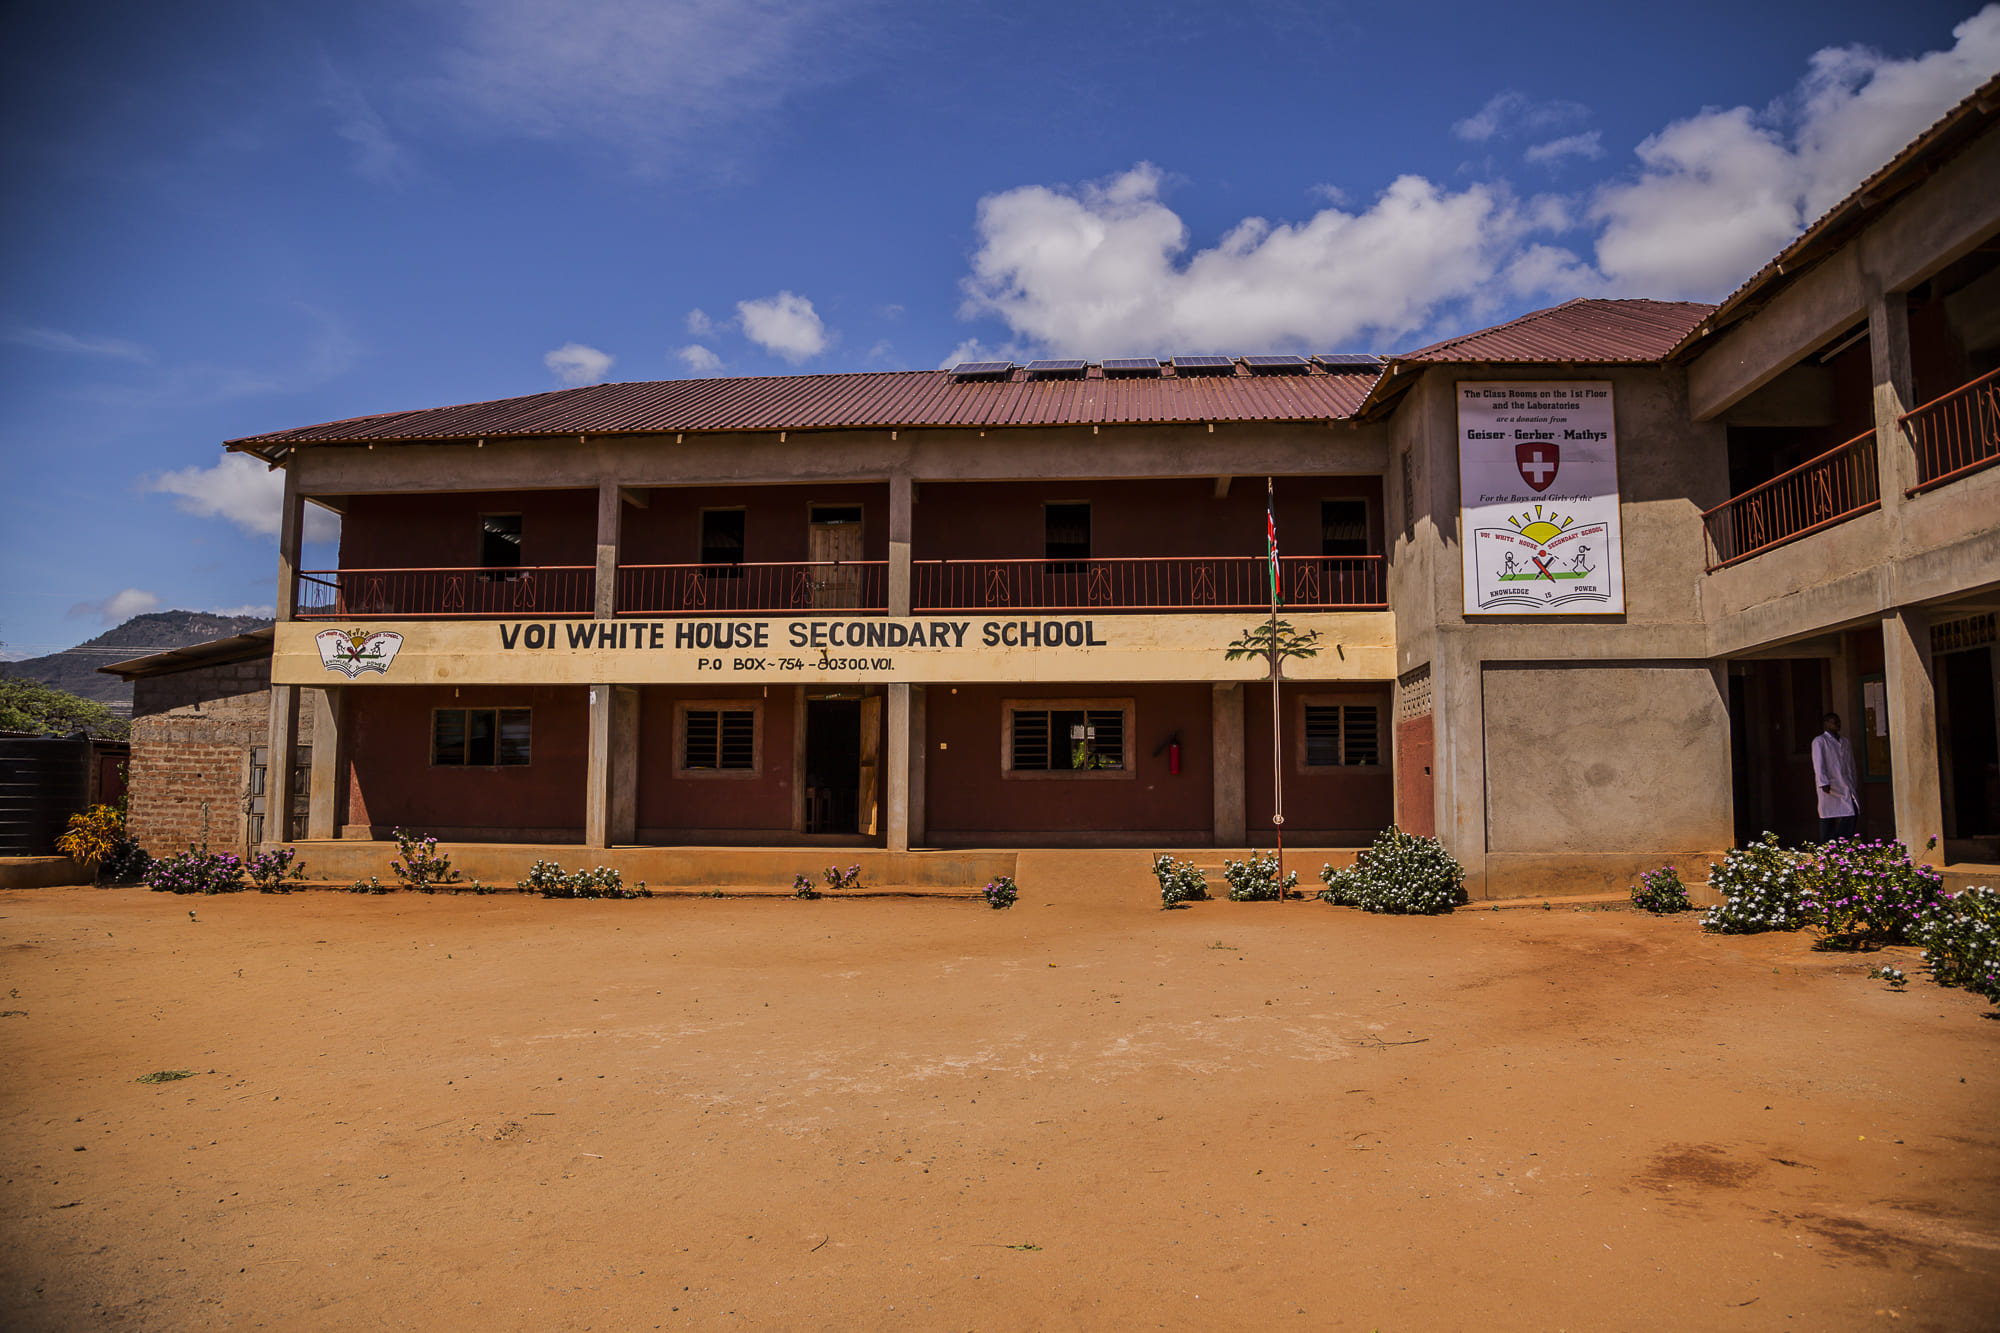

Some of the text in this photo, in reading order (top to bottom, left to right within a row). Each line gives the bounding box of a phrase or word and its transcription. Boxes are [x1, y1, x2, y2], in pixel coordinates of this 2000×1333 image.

[1464, 390, 1480, 398] The
[1483, 390, 1506, 398] Class
[1508, 390, 1537, 398] Rooms
[1553, 390, 1567, 398] the
[1570, 390, 1583, 398] 1st
[1586, 389, 1607, 398] Floor
[1492, 401, 1580, 410] and the Laboratories
[1548, 416, 1567, 424] from
[1467, 429, 1506, 440] Geiser
[1514, 429, 1555, 440] Gerber
[1563, 429, 1607, 442] Mathys
[1480, 494, 1494, 502] For
[1495, 494, 1508, 502] the
[1510, 494, 1529, 503] Boys
[1548, 493, 1568, 502] Girls
[1569, 493, 1580, 503] of
[1579, 494, 1592, 502] the
[1495, 534, 1514, 542] WHITE
[1518, 539, 1538, 550] HOUSE
[1547, 532, 1579, 550] SECONDARY
[1581, 526, 1603, 536] SCHOOL
[1489, 588, 1530, 597] KNOWLEDGE
[500, 620, 1107, 650] VOI WHITE HOUSE SECONDARY SCHOOL
